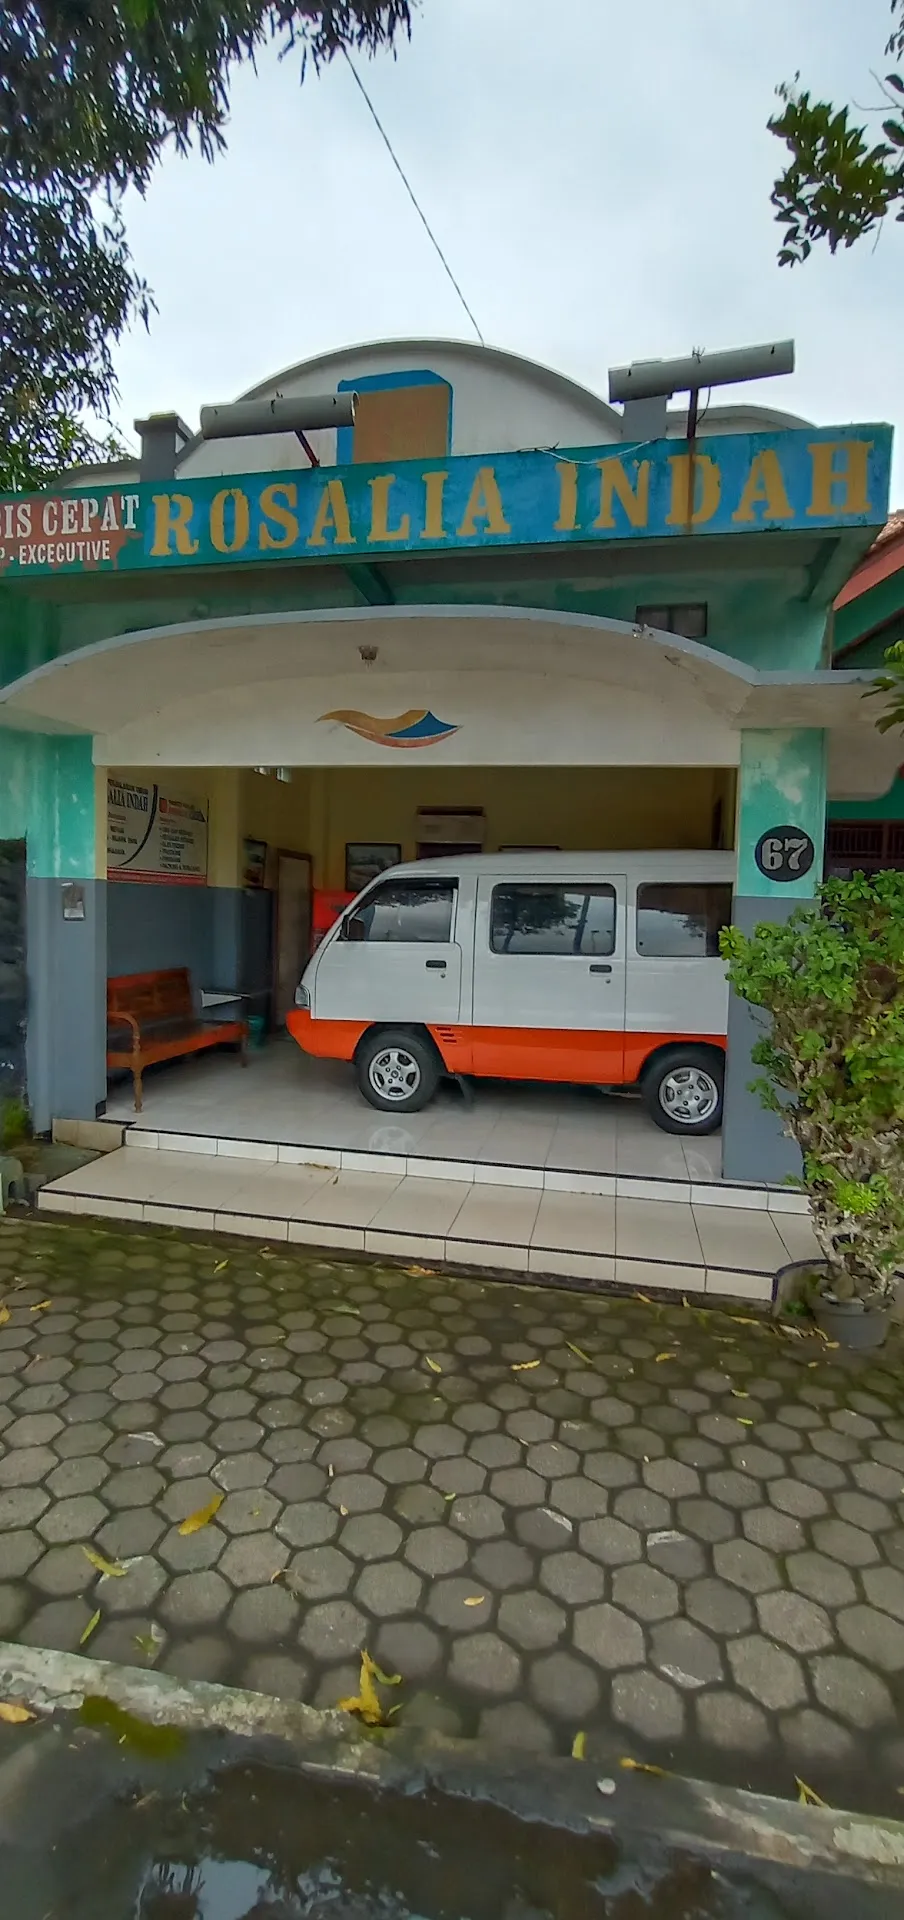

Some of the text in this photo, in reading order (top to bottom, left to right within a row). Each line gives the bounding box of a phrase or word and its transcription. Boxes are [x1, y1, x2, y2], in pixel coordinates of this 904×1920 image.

[0, 494, 140, 538] IS CEPAT
[149, 440, 875, 557] ROSALIA INDAH
[19, 539, 111, 565] EXCECUTIVE
[761, 838, 809, 871] 67
